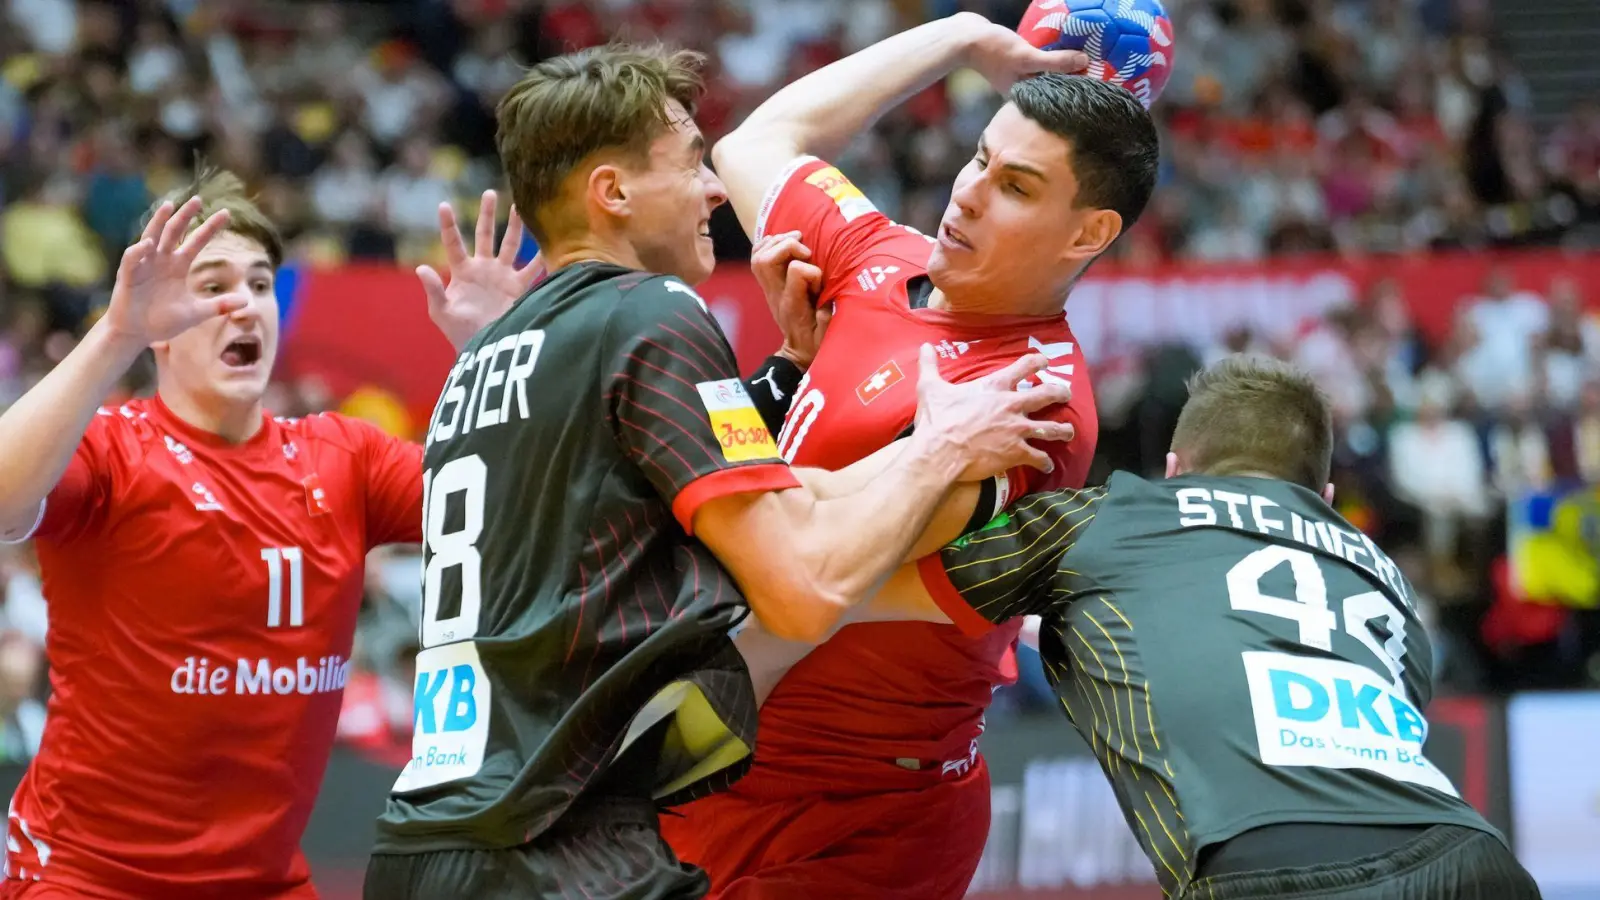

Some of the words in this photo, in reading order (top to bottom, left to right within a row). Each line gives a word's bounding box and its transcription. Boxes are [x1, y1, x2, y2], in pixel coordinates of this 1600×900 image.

[261, 547, 303, 627] 11
[170, 656, 229, 695] die
[1268, 669, 1424, 744] DKB
[427, 744, 466, 766] Bank
[1280, 728, 1325, 748] Das
